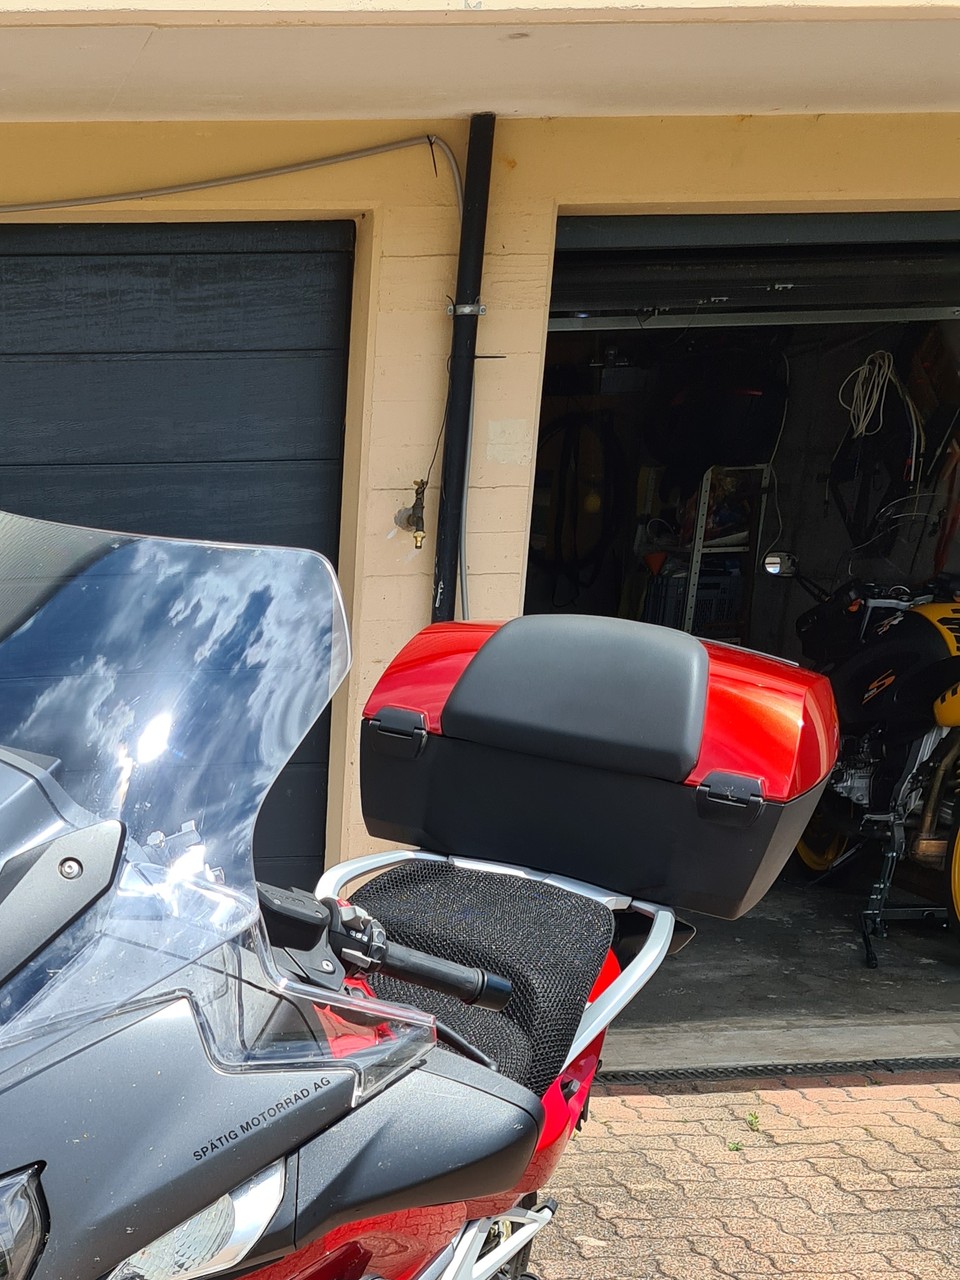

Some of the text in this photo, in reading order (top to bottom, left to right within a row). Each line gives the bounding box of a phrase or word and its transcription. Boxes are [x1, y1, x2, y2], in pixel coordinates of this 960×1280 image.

[193, 1077, 331, 1161] SPÄTIG MOTORRAD AG
